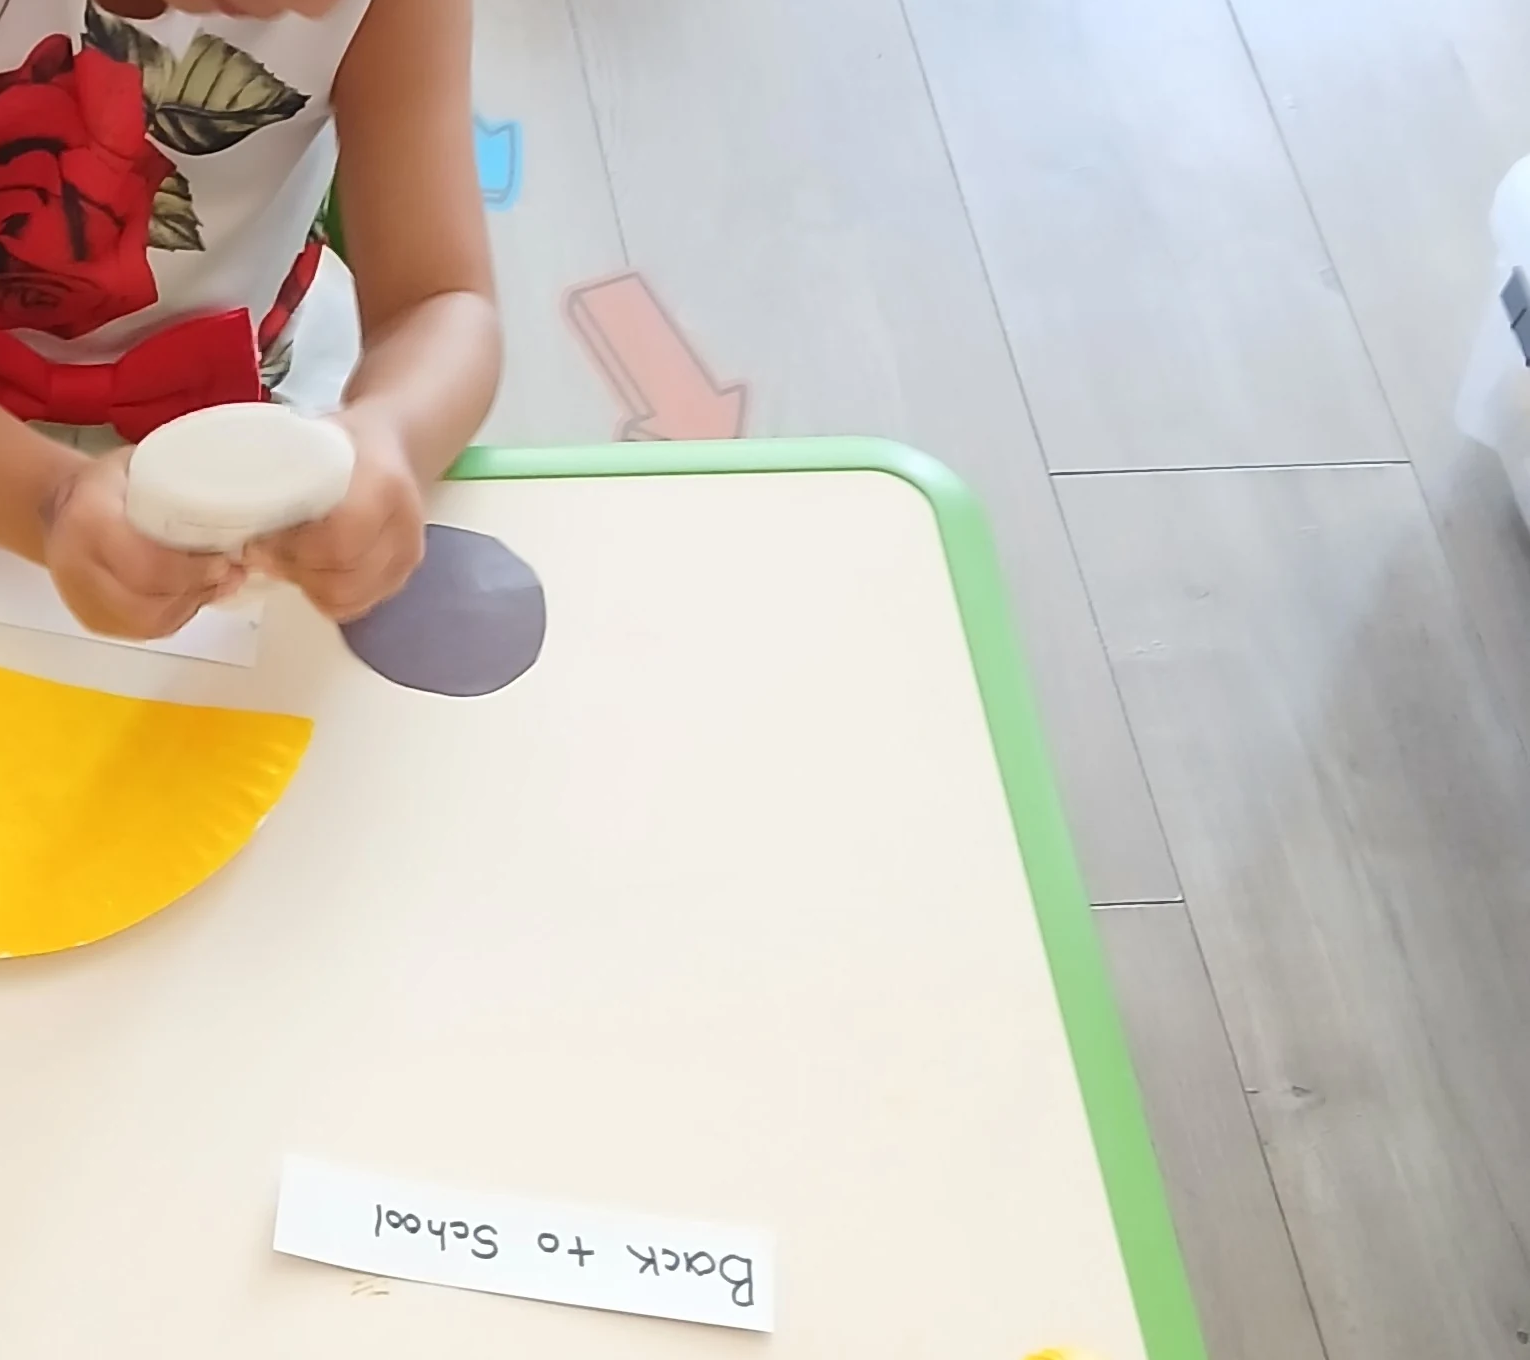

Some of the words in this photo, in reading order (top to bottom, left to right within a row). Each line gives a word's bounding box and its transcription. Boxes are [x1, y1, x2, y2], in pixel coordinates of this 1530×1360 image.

[375, 1203, 499, 1259] School
[537, 1232, 595, 1267] to
[626, 1244, 754, 1307] Back
